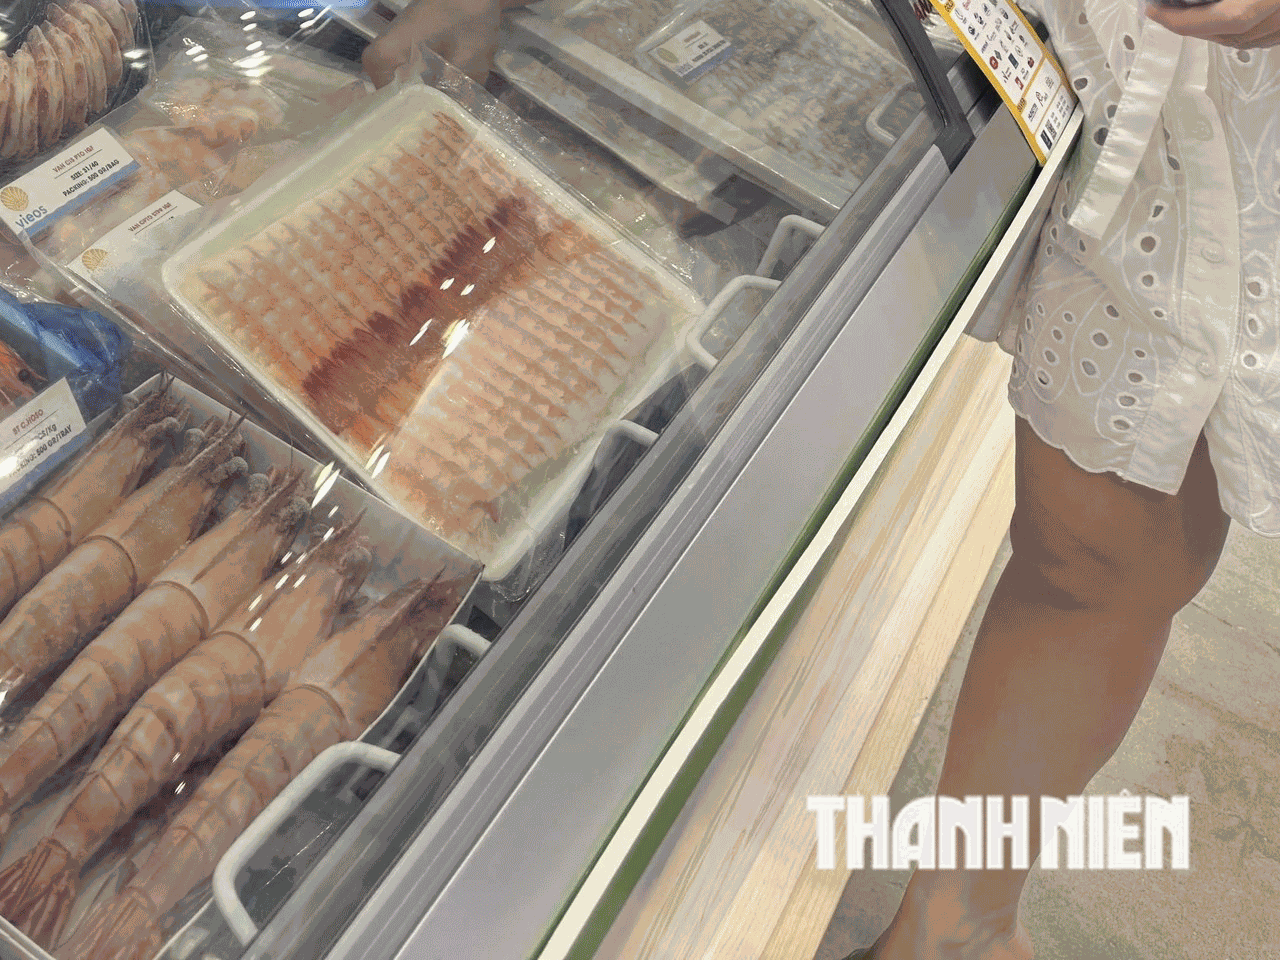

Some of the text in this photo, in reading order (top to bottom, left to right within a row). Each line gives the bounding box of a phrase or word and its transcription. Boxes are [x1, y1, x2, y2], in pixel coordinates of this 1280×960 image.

[70, 170, 83, 180] SIZE:
[62, 178, 88, 196] PACKING:
[15, 204, 49, 229] vieos
